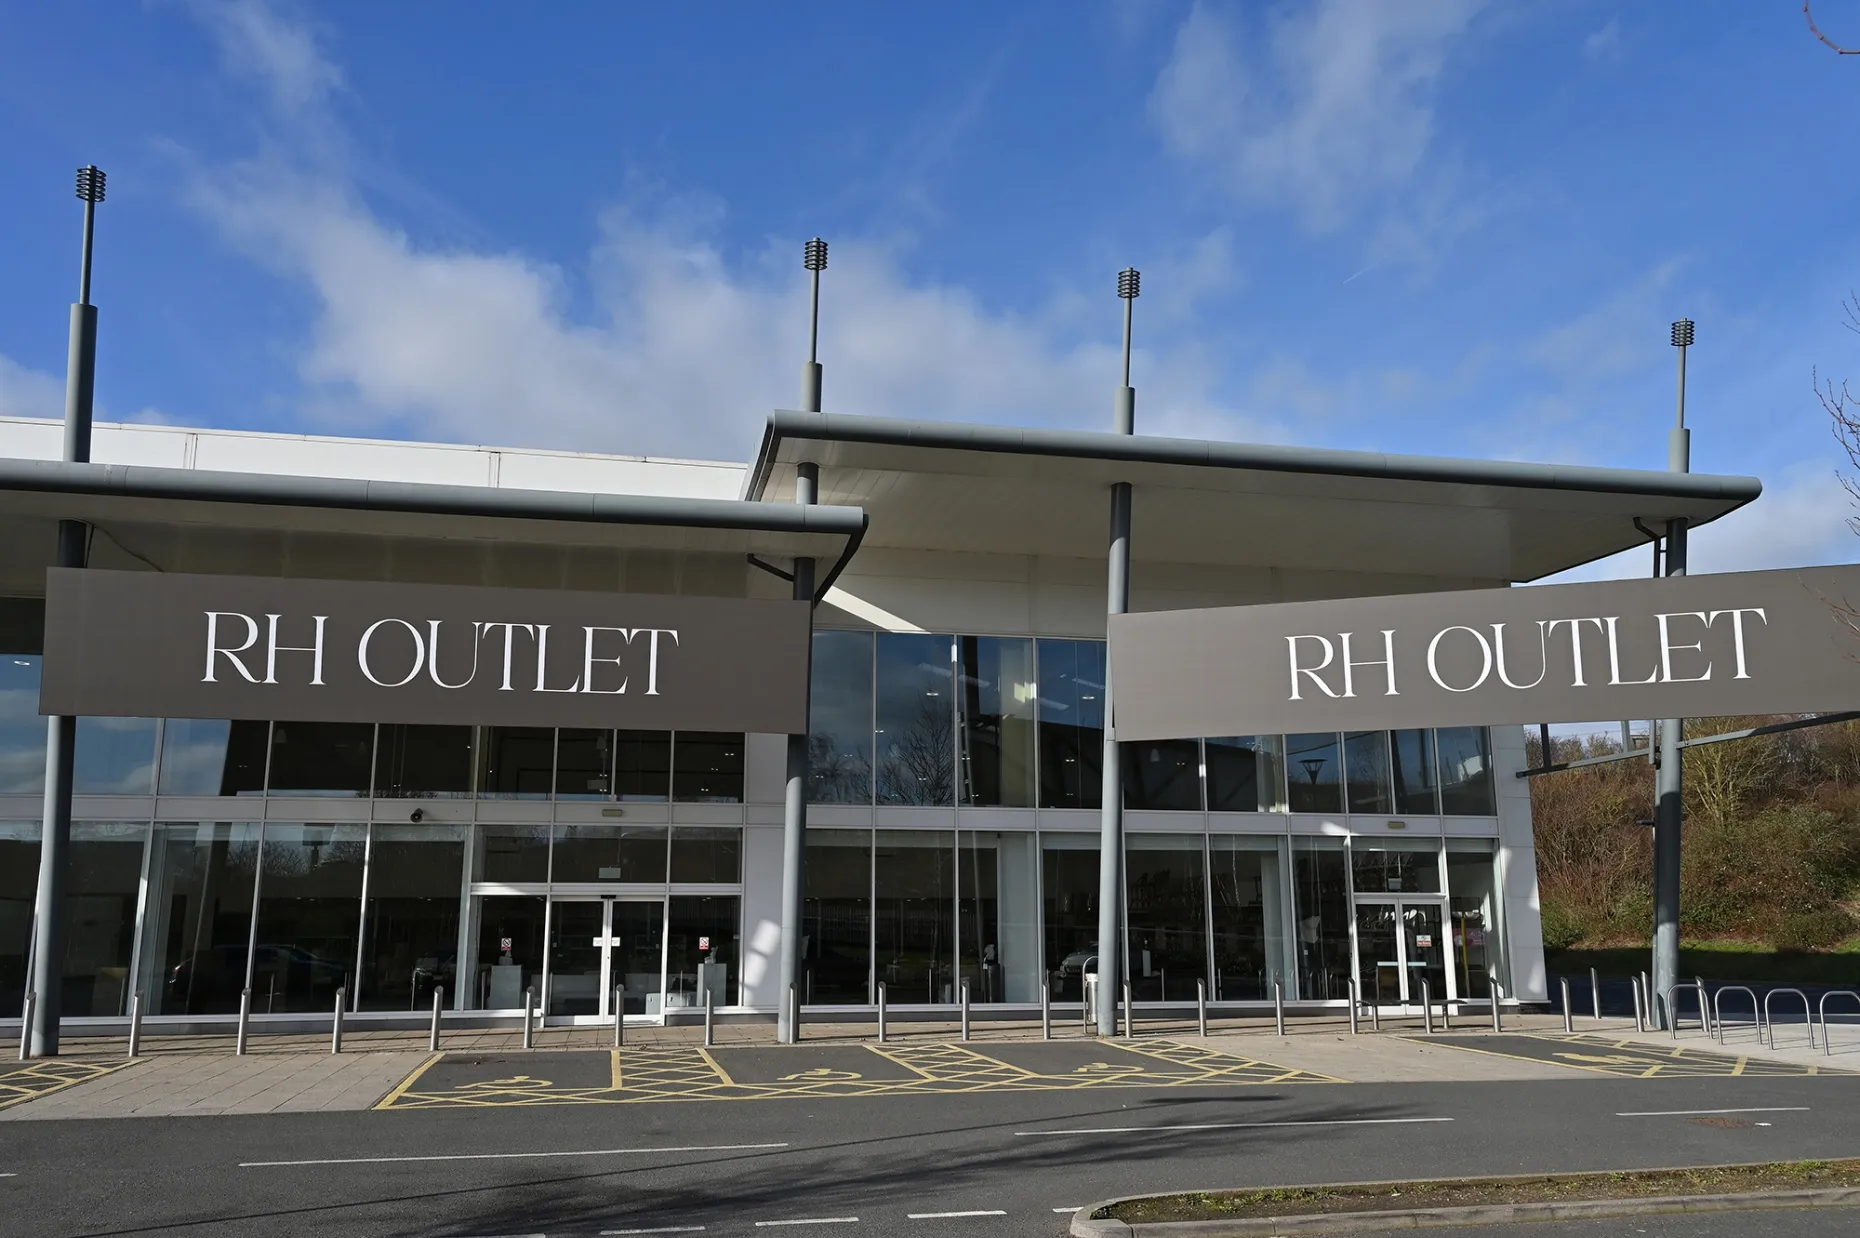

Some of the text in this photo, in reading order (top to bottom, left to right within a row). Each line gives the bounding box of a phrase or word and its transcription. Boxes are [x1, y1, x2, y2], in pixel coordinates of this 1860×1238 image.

[201, 612, 679, 695] RH OUTLET
[1284, 608, 1767, 700] RH OUTLET
